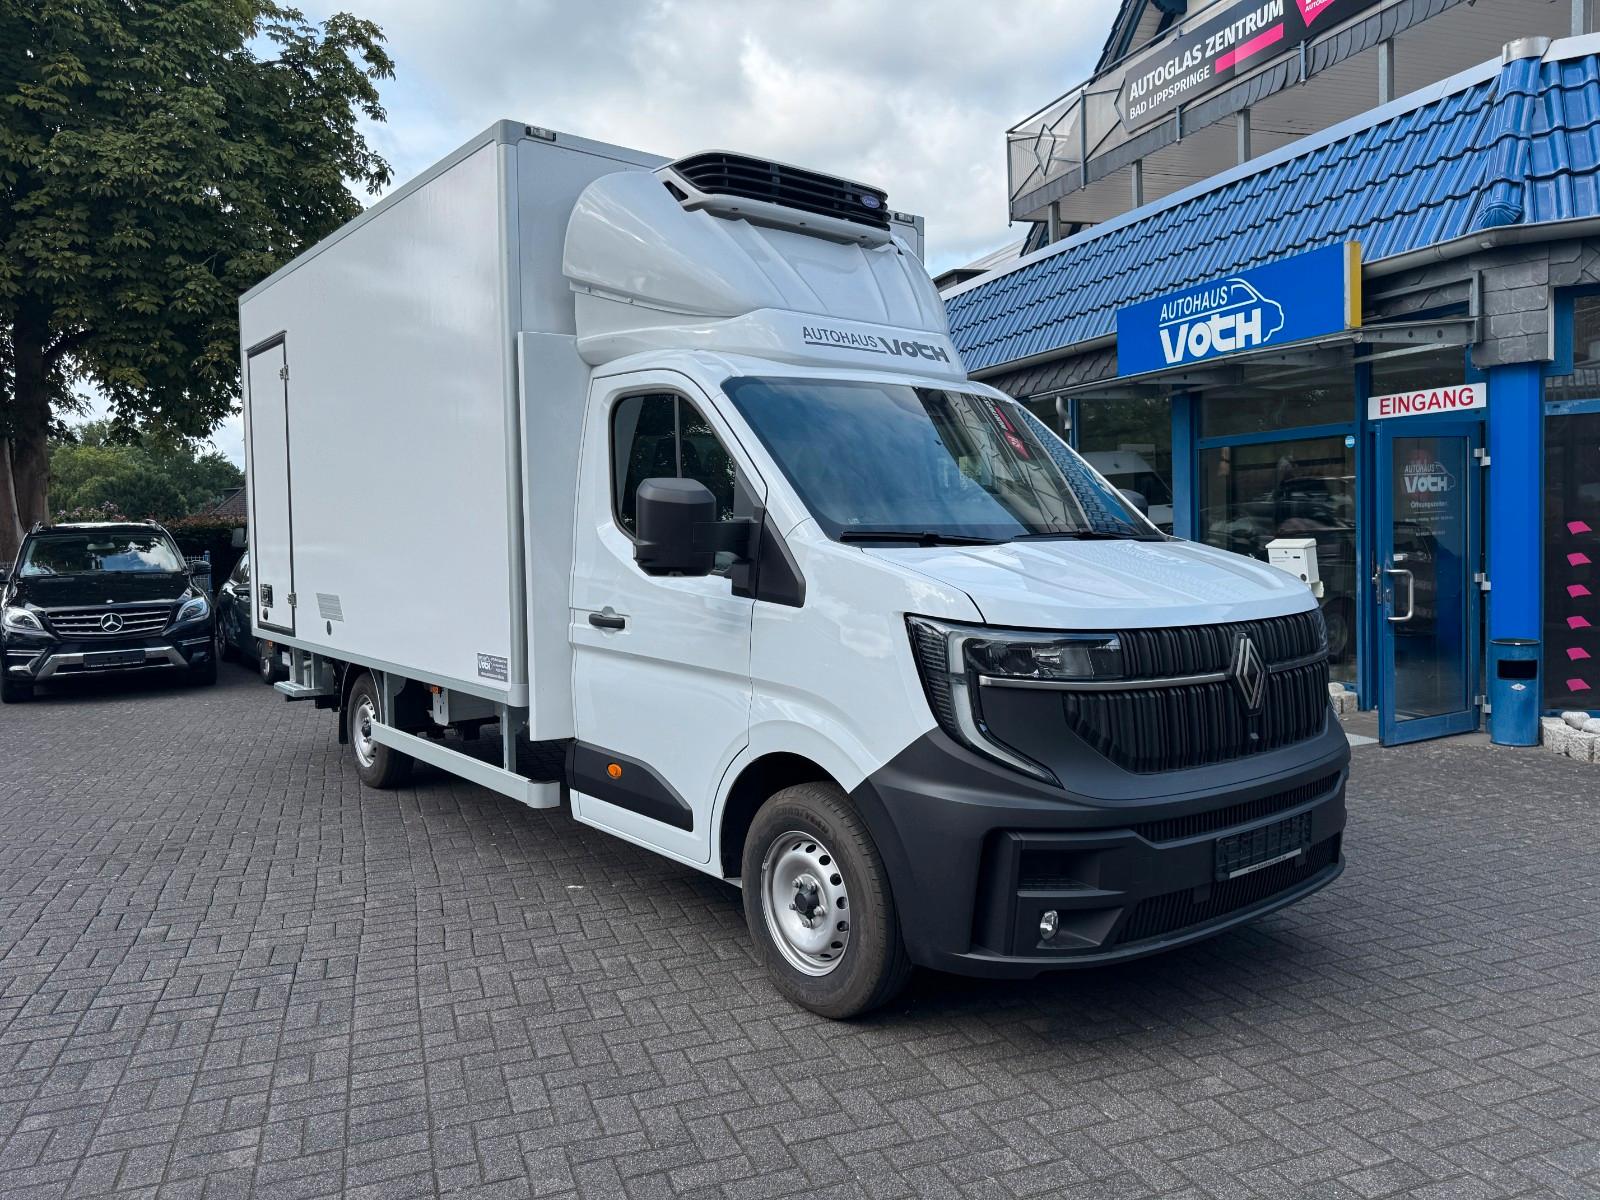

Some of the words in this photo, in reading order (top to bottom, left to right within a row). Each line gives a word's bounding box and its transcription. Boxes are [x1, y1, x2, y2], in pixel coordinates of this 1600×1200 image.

[1129, 44, 1203, 102] AUTOGLAS
[1204, 0, 1284, 59] ZENTRUM
[1129, 100, 1147, 120] BAD
[1148, 65, 1211, 111] LIPPSPRINGE
[1159, 286, 1228, 322] AUTOHAUS
[802, 326, 878, 348] AUTOHAUS
[1379, 387, 1474, 416] EINGANG
